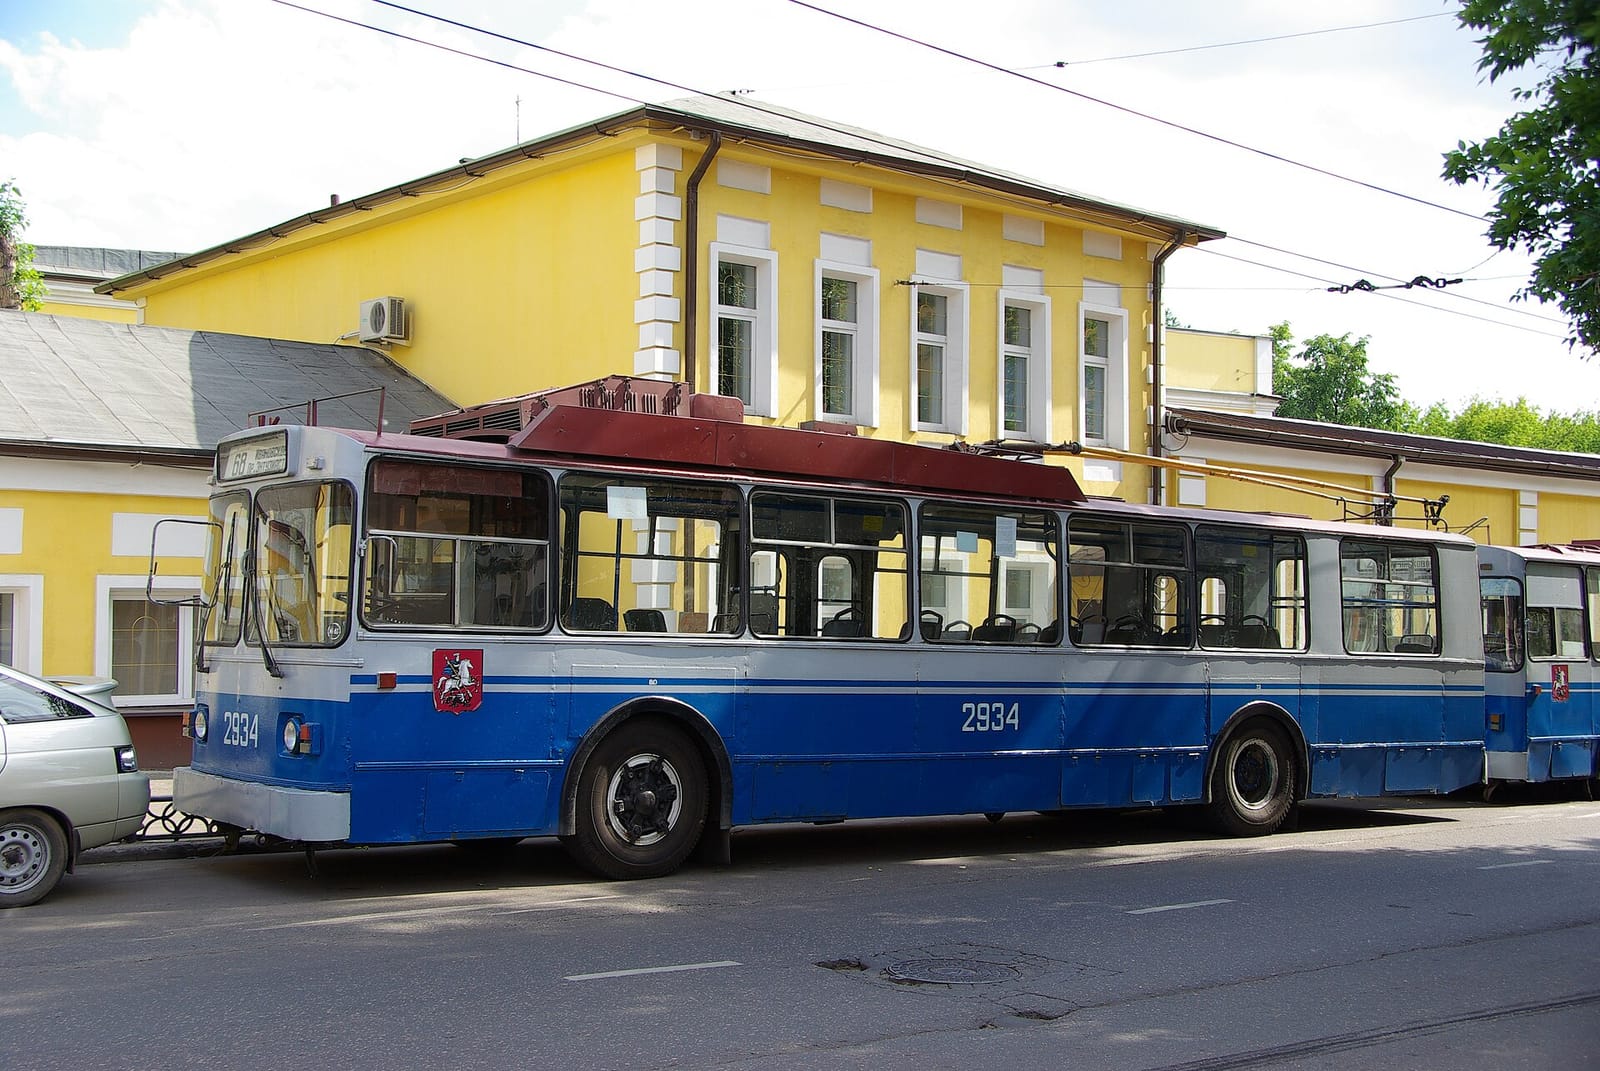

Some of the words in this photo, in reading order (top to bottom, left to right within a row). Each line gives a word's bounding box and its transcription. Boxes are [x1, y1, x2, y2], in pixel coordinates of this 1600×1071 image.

[232, 452, 247, 475] 68
[224, 711, 258, 748] 2934
[962, 703, 1019, 731] 2934
